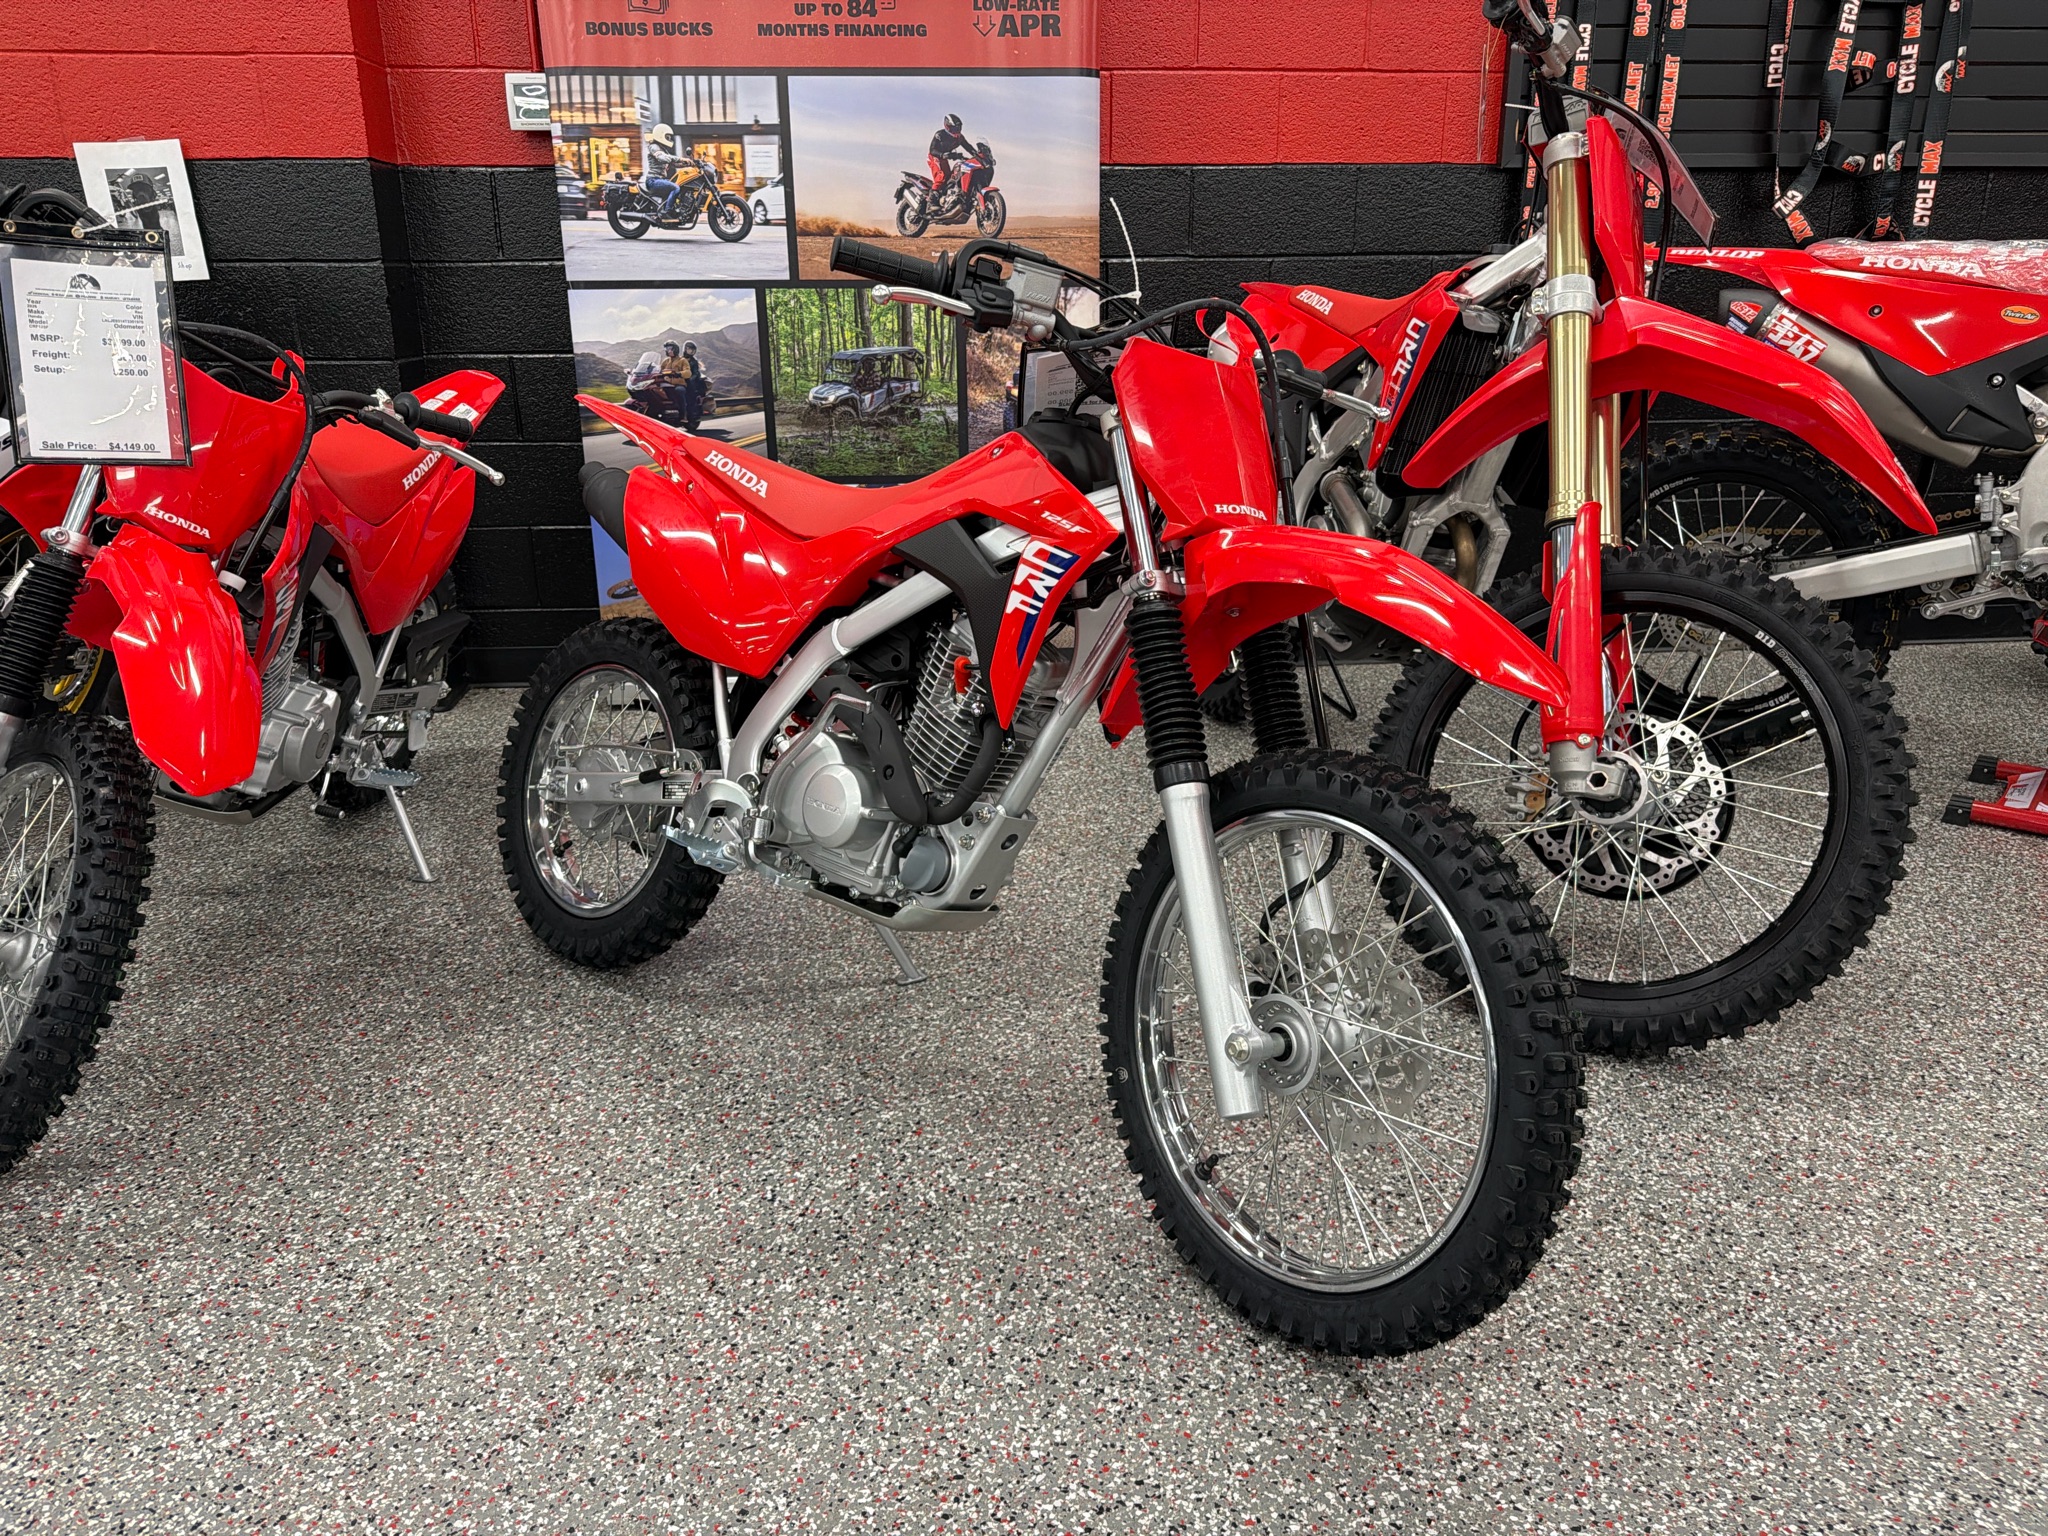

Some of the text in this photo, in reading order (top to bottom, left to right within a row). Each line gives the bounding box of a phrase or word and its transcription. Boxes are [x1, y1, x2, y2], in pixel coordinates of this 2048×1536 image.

[794, 0, 878, 17] UP TO 84
[973, 0, 1060, 11] LOW-RATE
[585, 22, 713, 36] BONUS BUCKS
[757, 23, 928, 37] MONTHS FINANCING
[997, 14, 1061, 37] APR
[1828, 38, 1853, 72] MAX
[1896, 3, 1924, 94] CYCLE MAX
[1912, 140, 1944, 227] CYCLE MAX
[1785, 210, 1815, 244] MAX
[1873, 215, 1892, 239] AX
[1668, 249, 1766, 259] DUNLOP
[1860, 254, 1987, 279] HONDA
[1296, 288, 1335, 316] HONDA
[2003, 309, 2039, 321] Twin Air
[30, 333, 64, 343] MSRP:
[32, 350, 71, 360] Freight:
[34, 365, 66, 375] Setup:
[42, 441, 156, 451] Sale Price: $4,149.00
[402, 450, 442, 491] HONDA
[704, 449, 769, 498] HONDA
[147, 506, 211, 539] HONDA
[1040, 510, 1092, 535] 125F
[1214, 503, 1268, 521] HONDA
[1006, 540, 1073, 616] CRF
